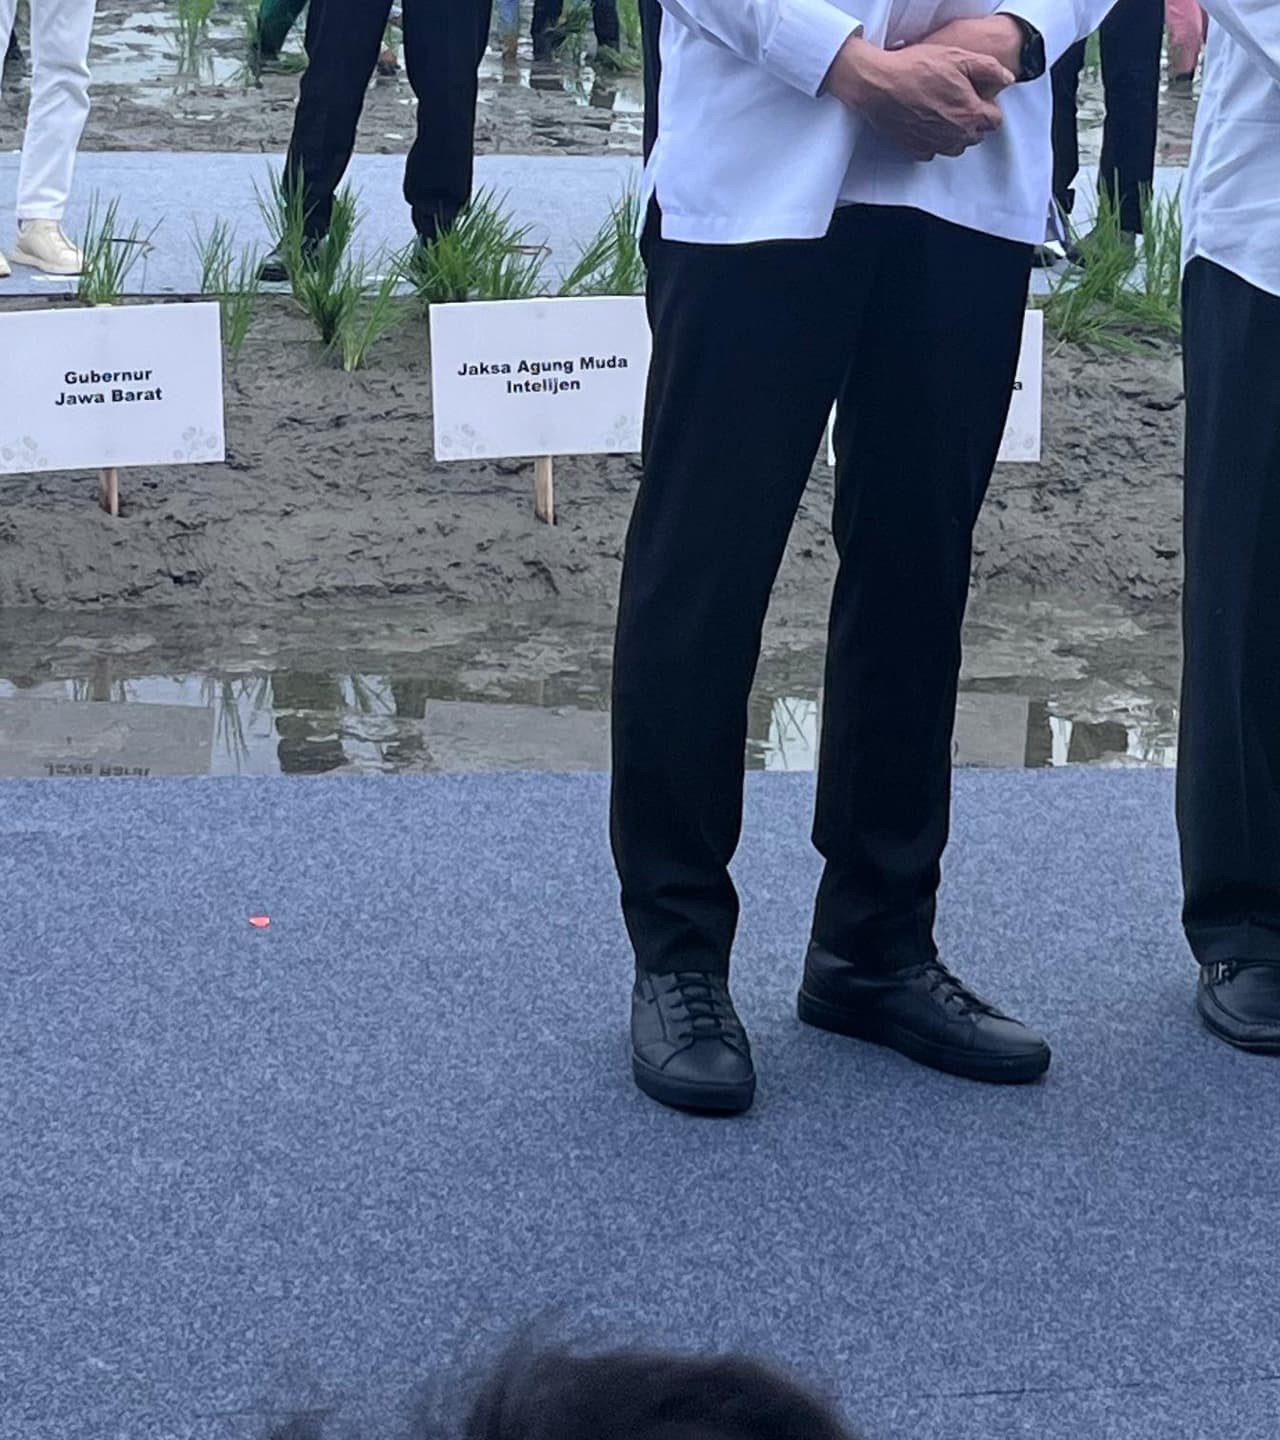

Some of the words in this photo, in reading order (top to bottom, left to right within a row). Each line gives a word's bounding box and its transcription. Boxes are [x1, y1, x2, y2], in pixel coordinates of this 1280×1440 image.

[457, 362, 511, 376] Jaksa
[517, 359, 573, 375] Agung
[580, 356, 628, 370] Muda
[64, 370, 152, 384] Gubernur
[506, 378, 581, 394] Intelijen
[55, 392, 105, 406] Jawa
[111, 387, 162, 402] Barat
